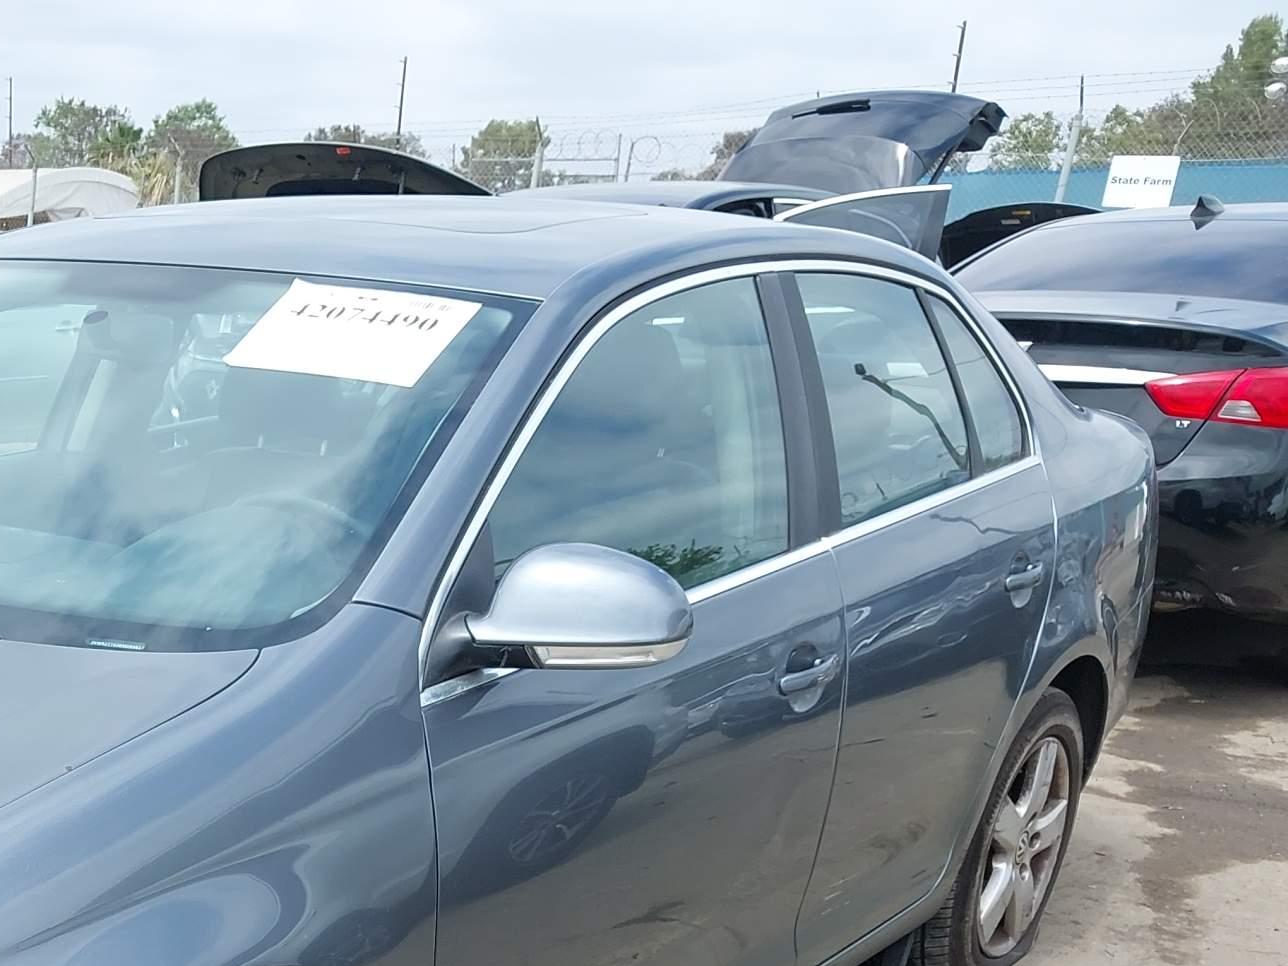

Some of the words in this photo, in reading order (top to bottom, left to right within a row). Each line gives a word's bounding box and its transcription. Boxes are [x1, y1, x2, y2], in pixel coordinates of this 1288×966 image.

[1111, 175, 1141, 185] State
[1143, 175, 1173, 186] Farm
[291, 302, 440, 332] 42074490
[1175, 419, 1191, 428] LT
